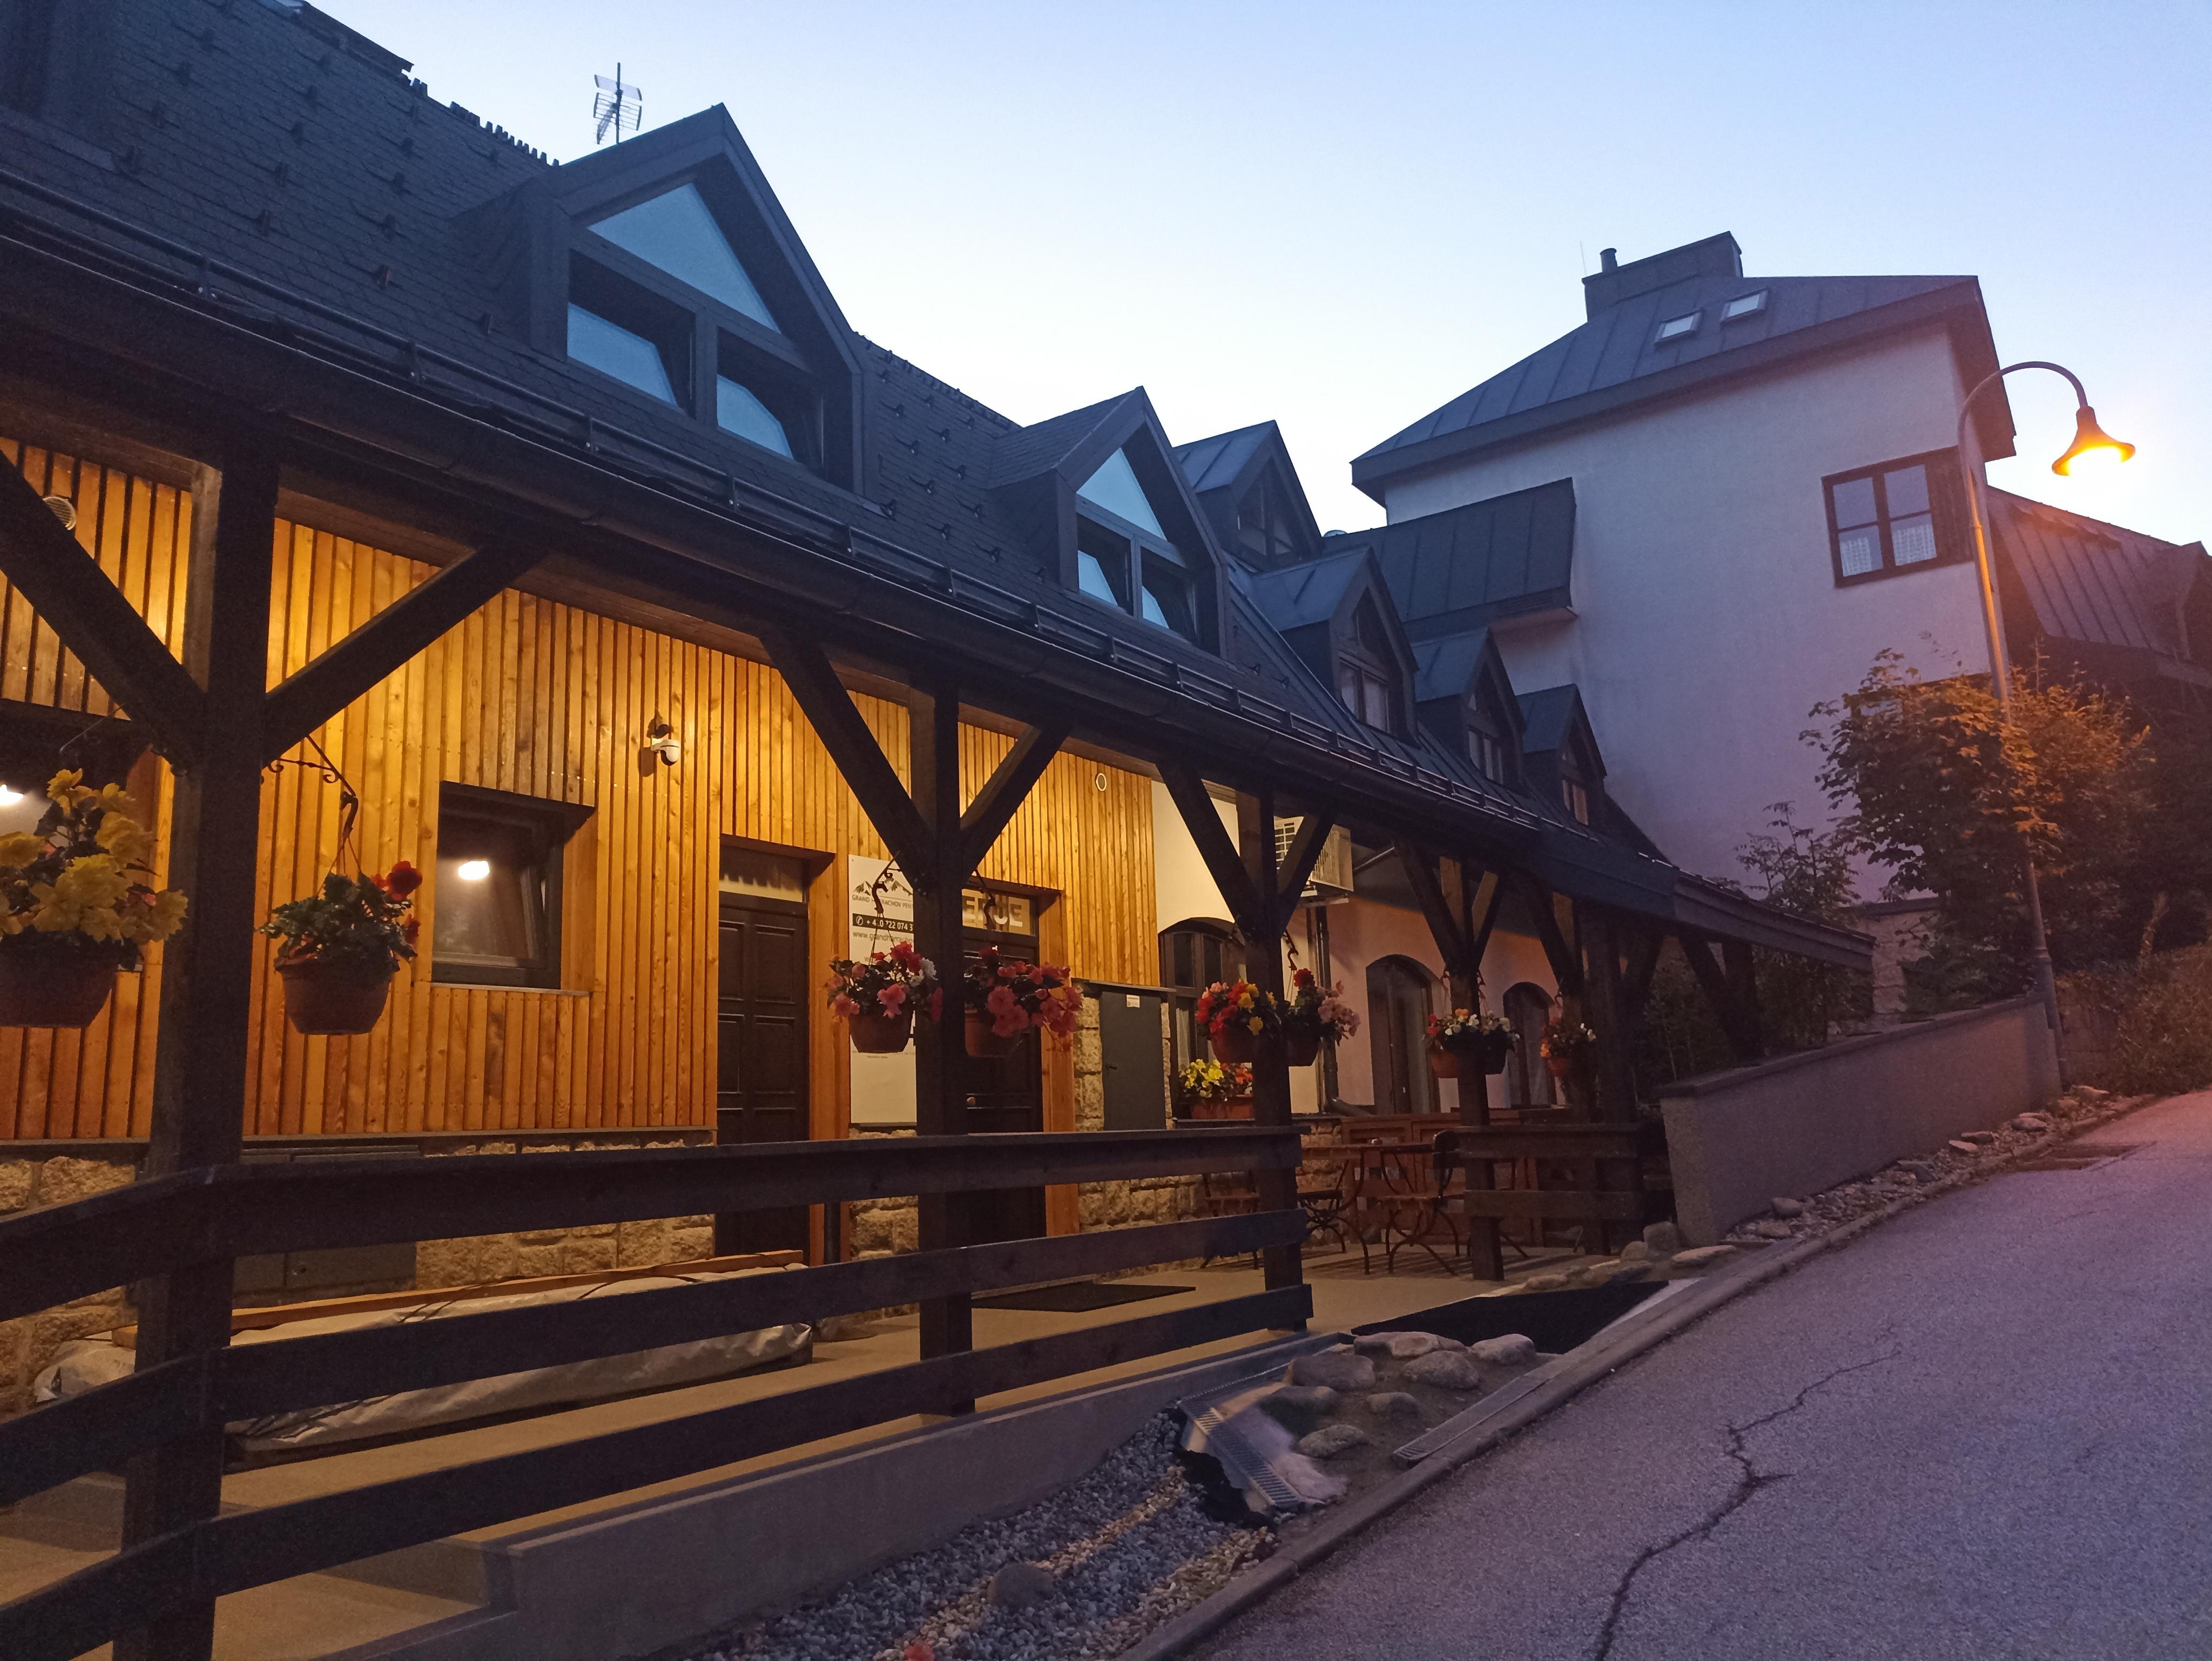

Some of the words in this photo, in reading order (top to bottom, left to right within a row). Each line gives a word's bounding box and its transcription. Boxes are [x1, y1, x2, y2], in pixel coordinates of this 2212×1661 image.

[852, 894, 870, 902] GRAND
[872, 919, 884, 927] 40
[897, 922, 908, 930] 074
